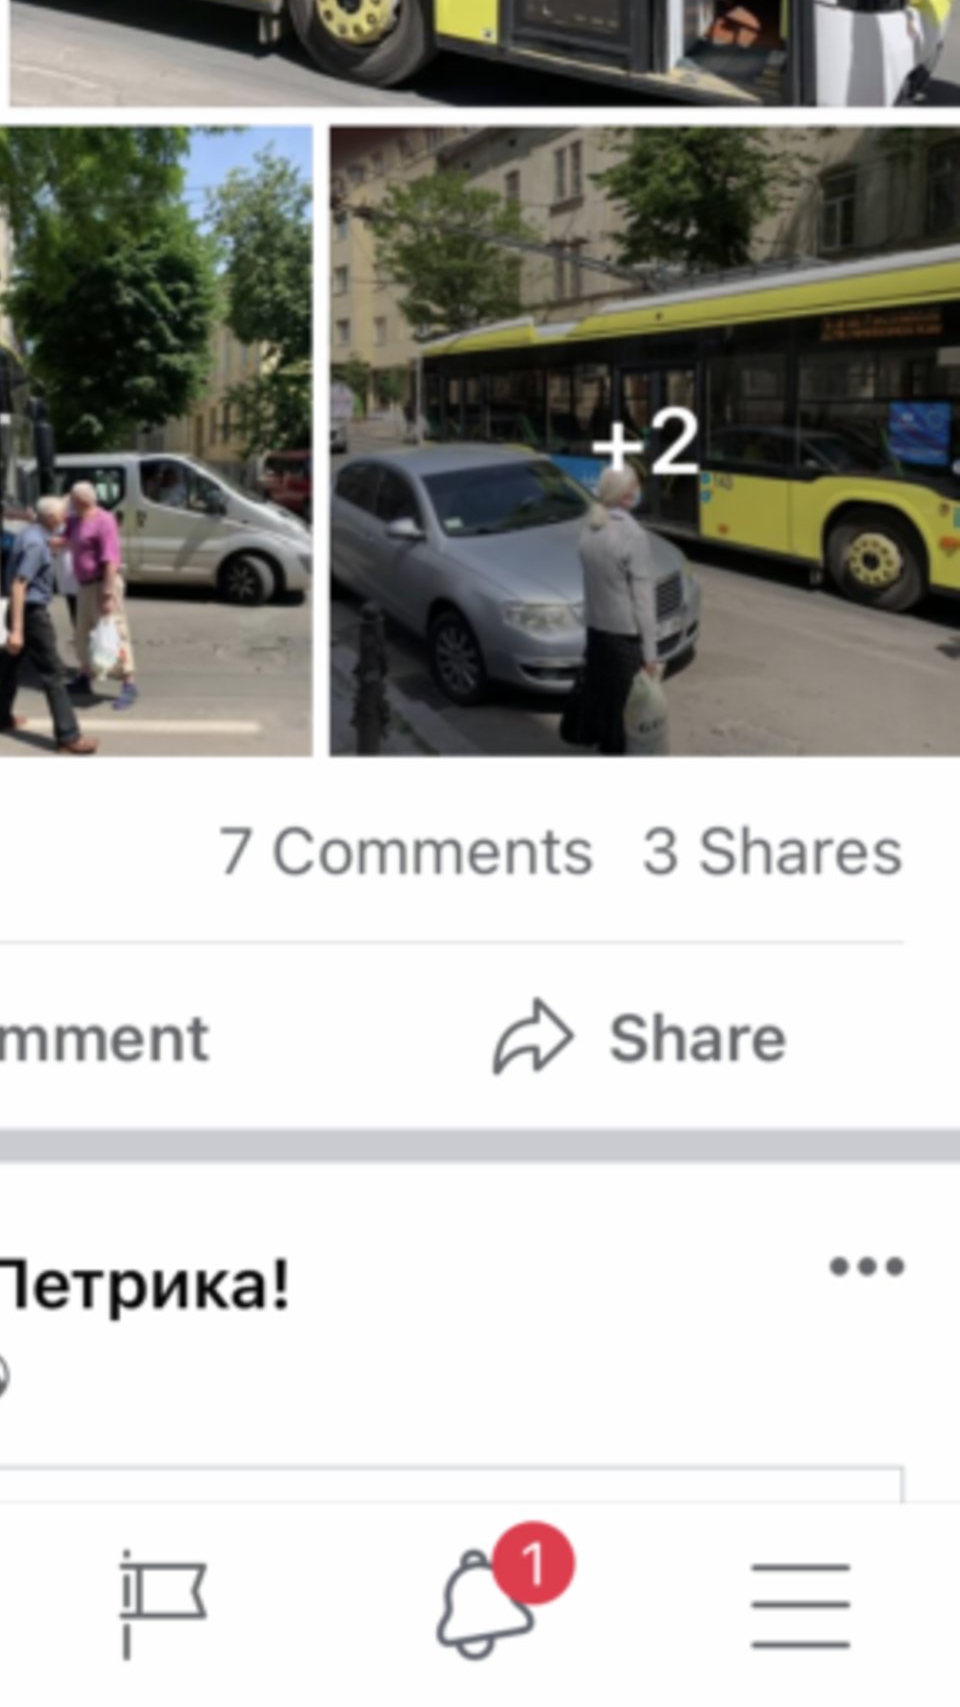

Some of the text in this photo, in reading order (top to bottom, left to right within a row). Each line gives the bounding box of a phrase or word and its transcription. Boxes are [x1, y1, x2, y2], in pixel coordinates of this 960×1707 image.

[220, 827, 593, 876] 7 Comments
[644, 826, 902, 876] 3 Shares
[611, 1013, 786, 1063] Share
[522, 1540, 542, 1587] 1
